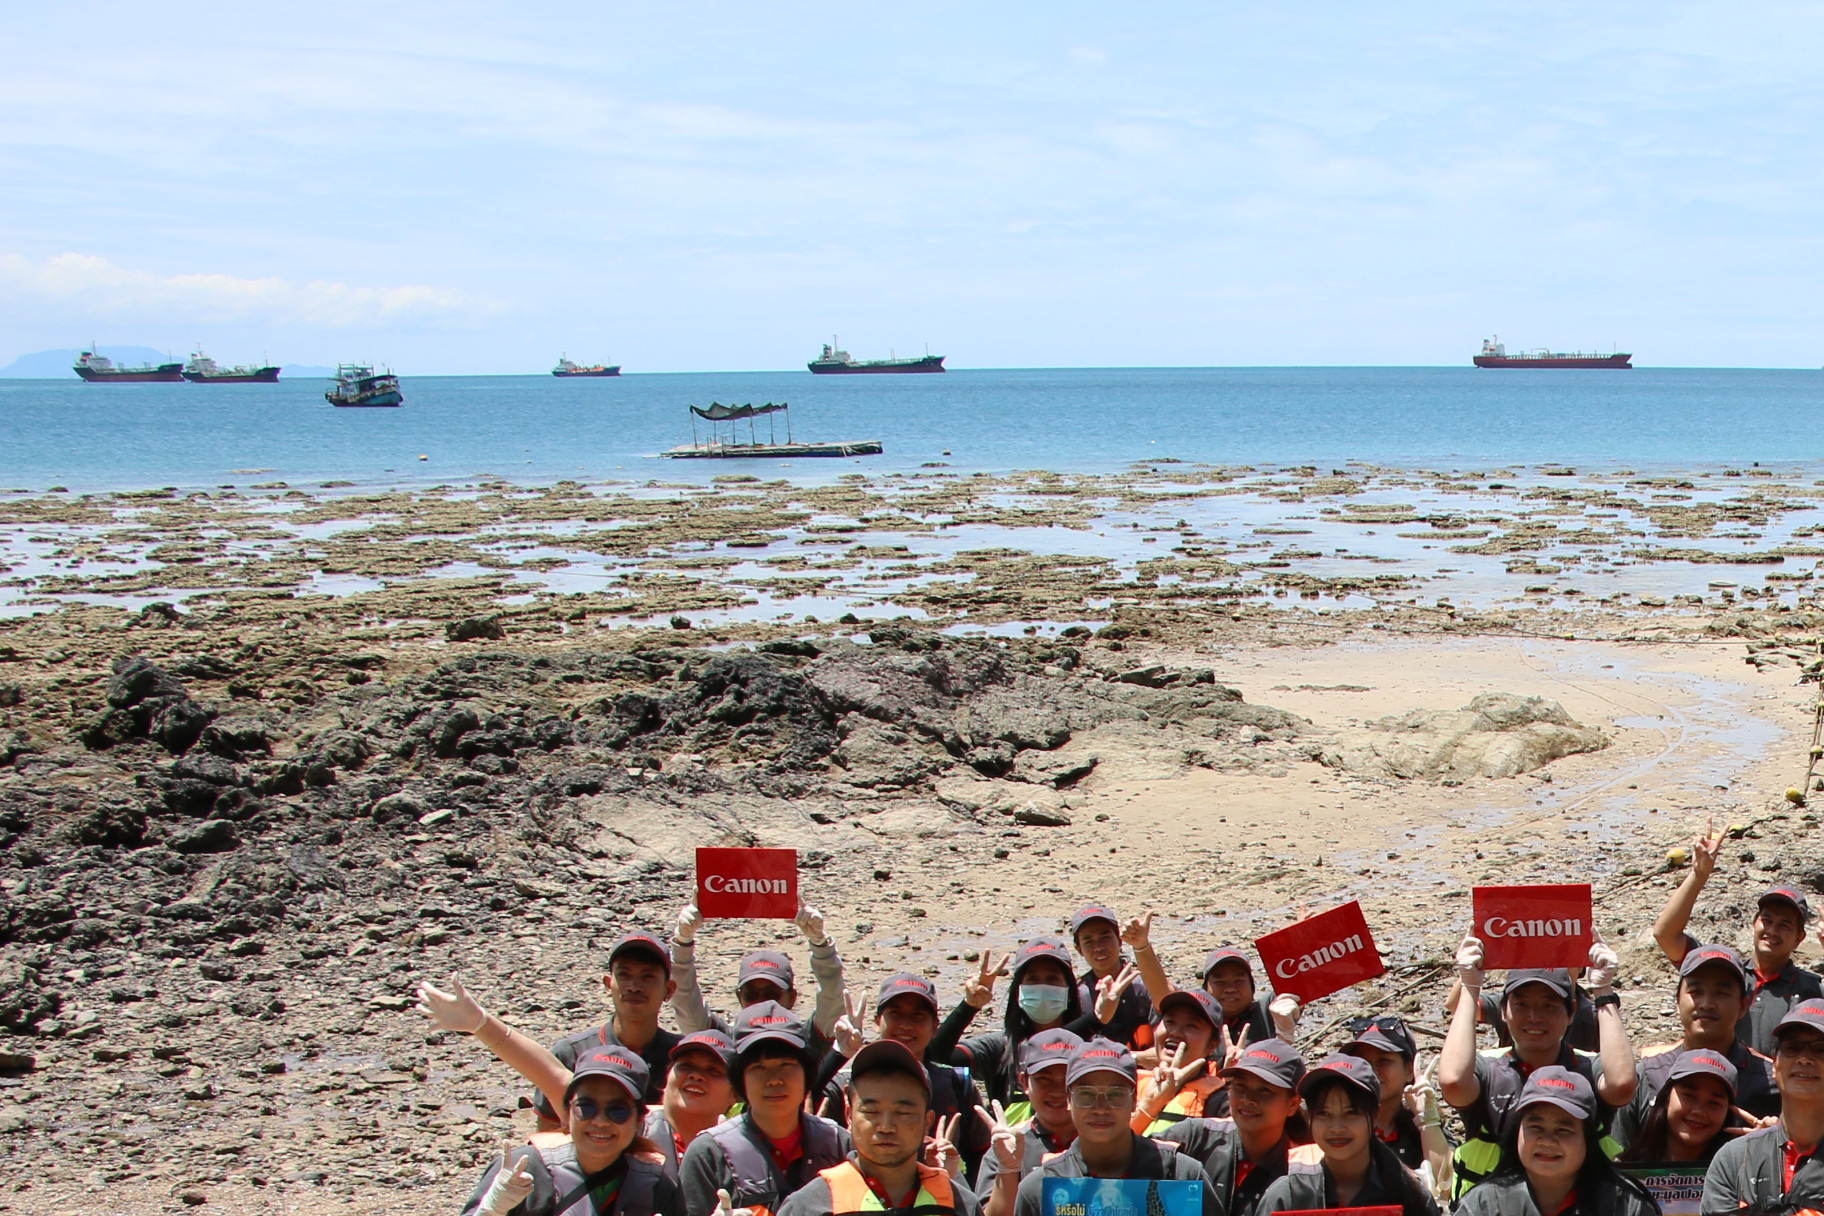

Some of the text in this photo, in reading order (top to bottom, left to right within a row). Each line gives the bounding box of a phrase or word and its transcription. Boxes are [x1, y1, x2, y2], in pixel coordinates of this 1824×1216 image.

[704, 875, 788, 894] Canon
[1483, 917, 1581, 938] Canon
[1276, 934, 1364, 979] Canon
[593, 1053, 634, 1069] Canon
